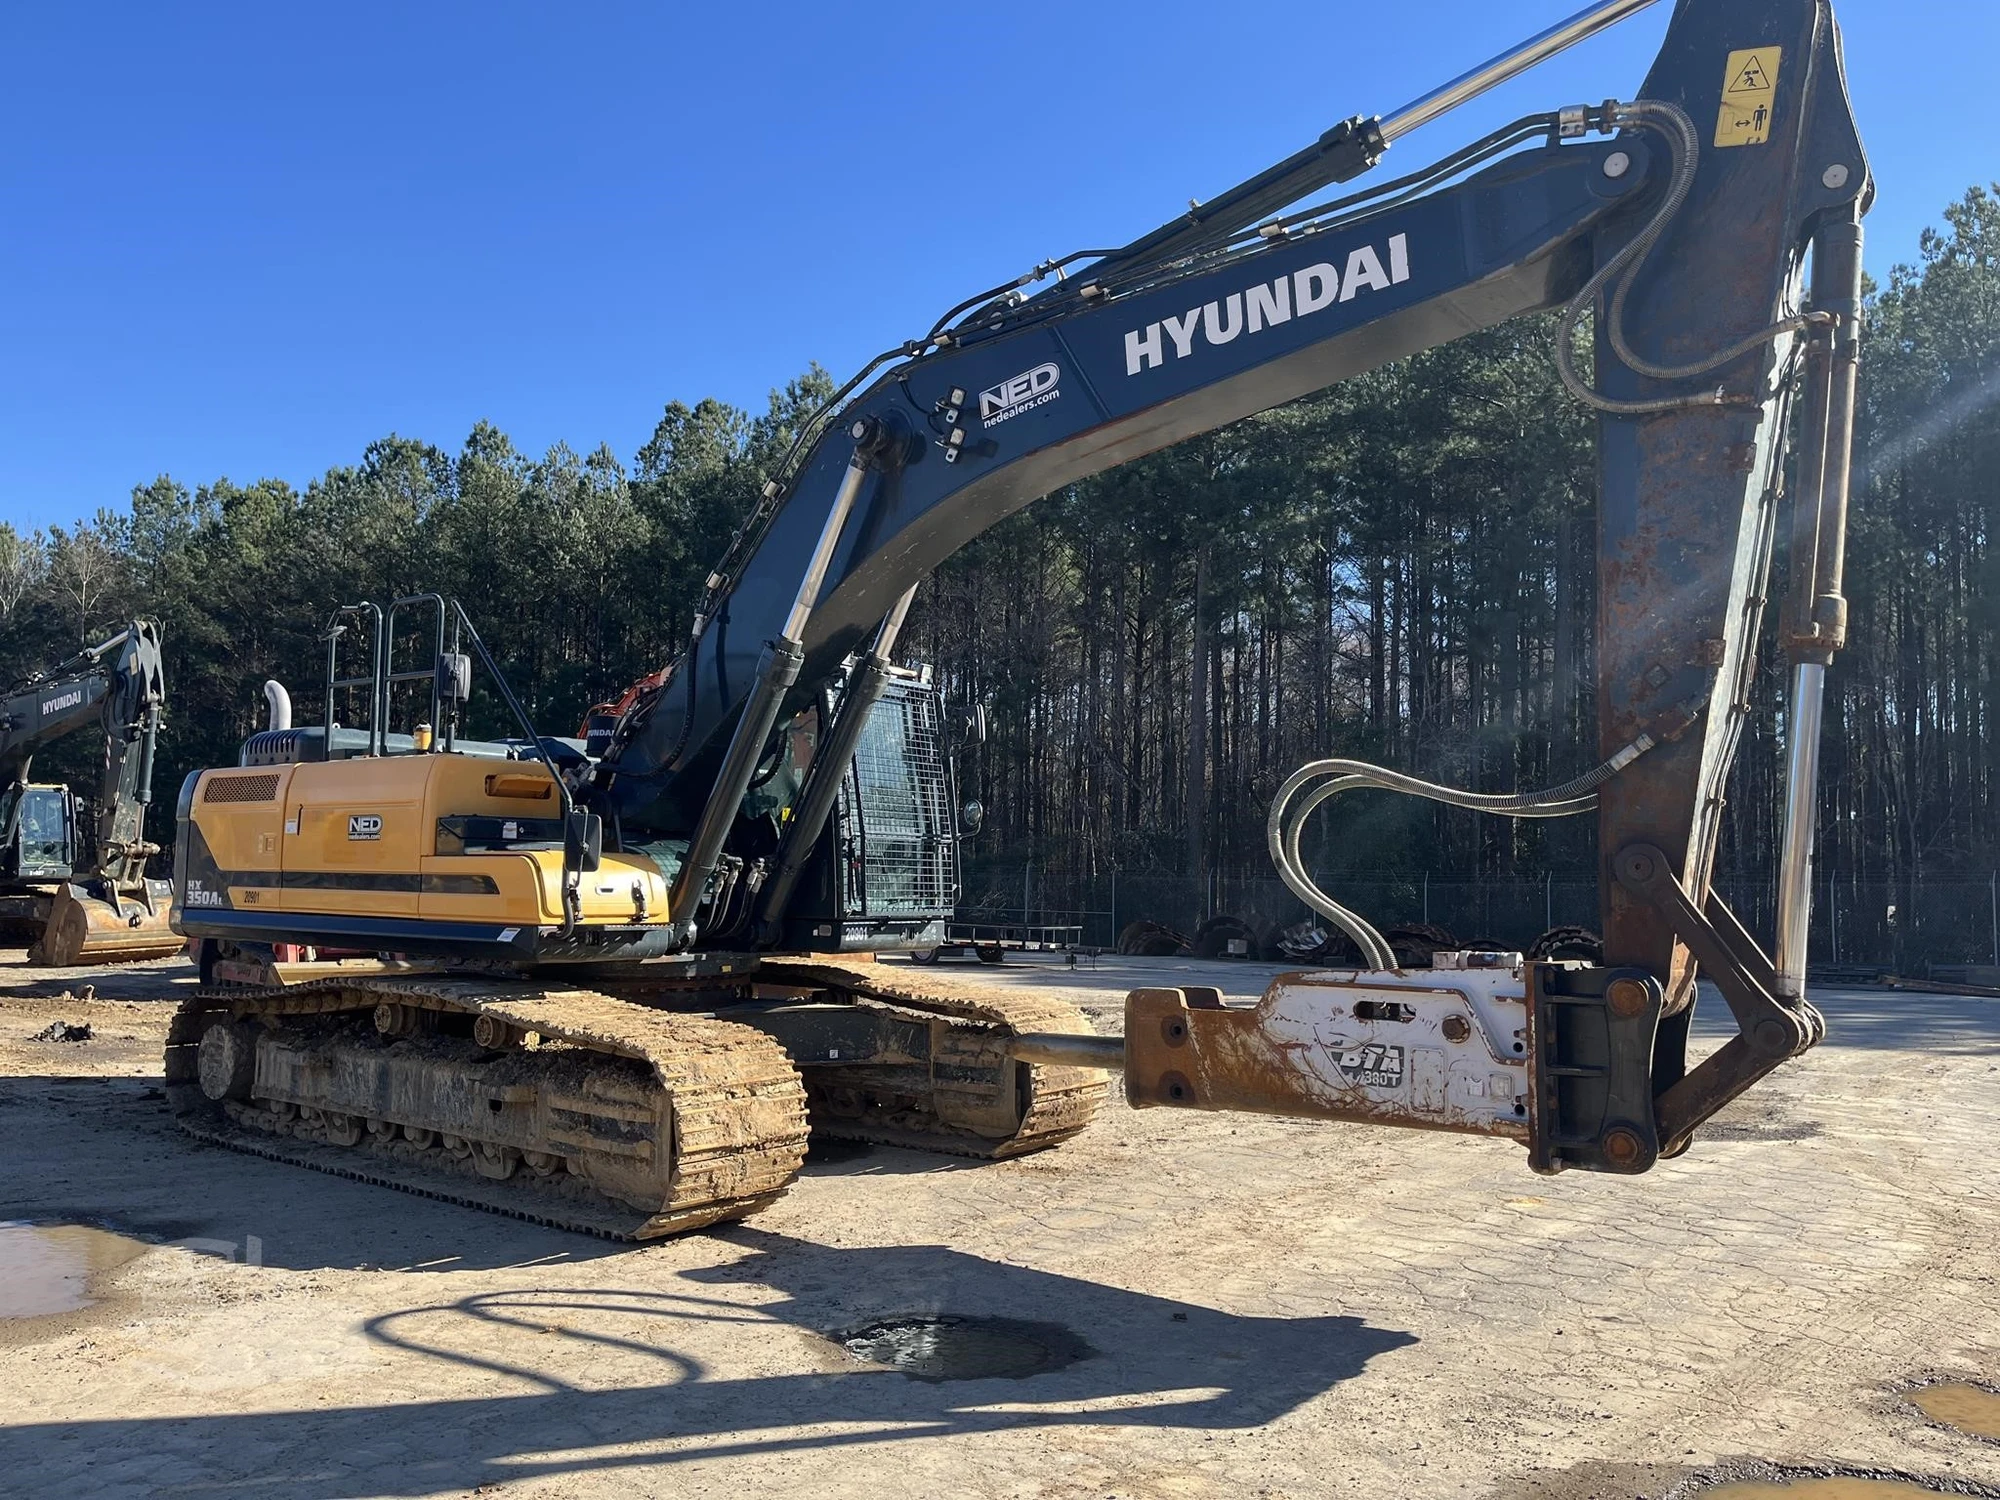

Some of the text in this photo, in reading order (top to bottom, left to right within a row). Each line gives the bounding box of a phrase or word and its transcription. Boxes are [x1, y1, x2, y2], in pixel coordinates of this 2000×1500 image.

[1124, 233, 1410, 376] HYUNDAI
[980, 363, 1059, 418] NED
[983, 389, 1060, 429] nedealers.com
[42, 690, 82, 716] HYUNDAI
[349, 815, 383, 832] NED
[188, 880, 202, 890] HX
[1364, 1070, 1401, 1087] 380T
